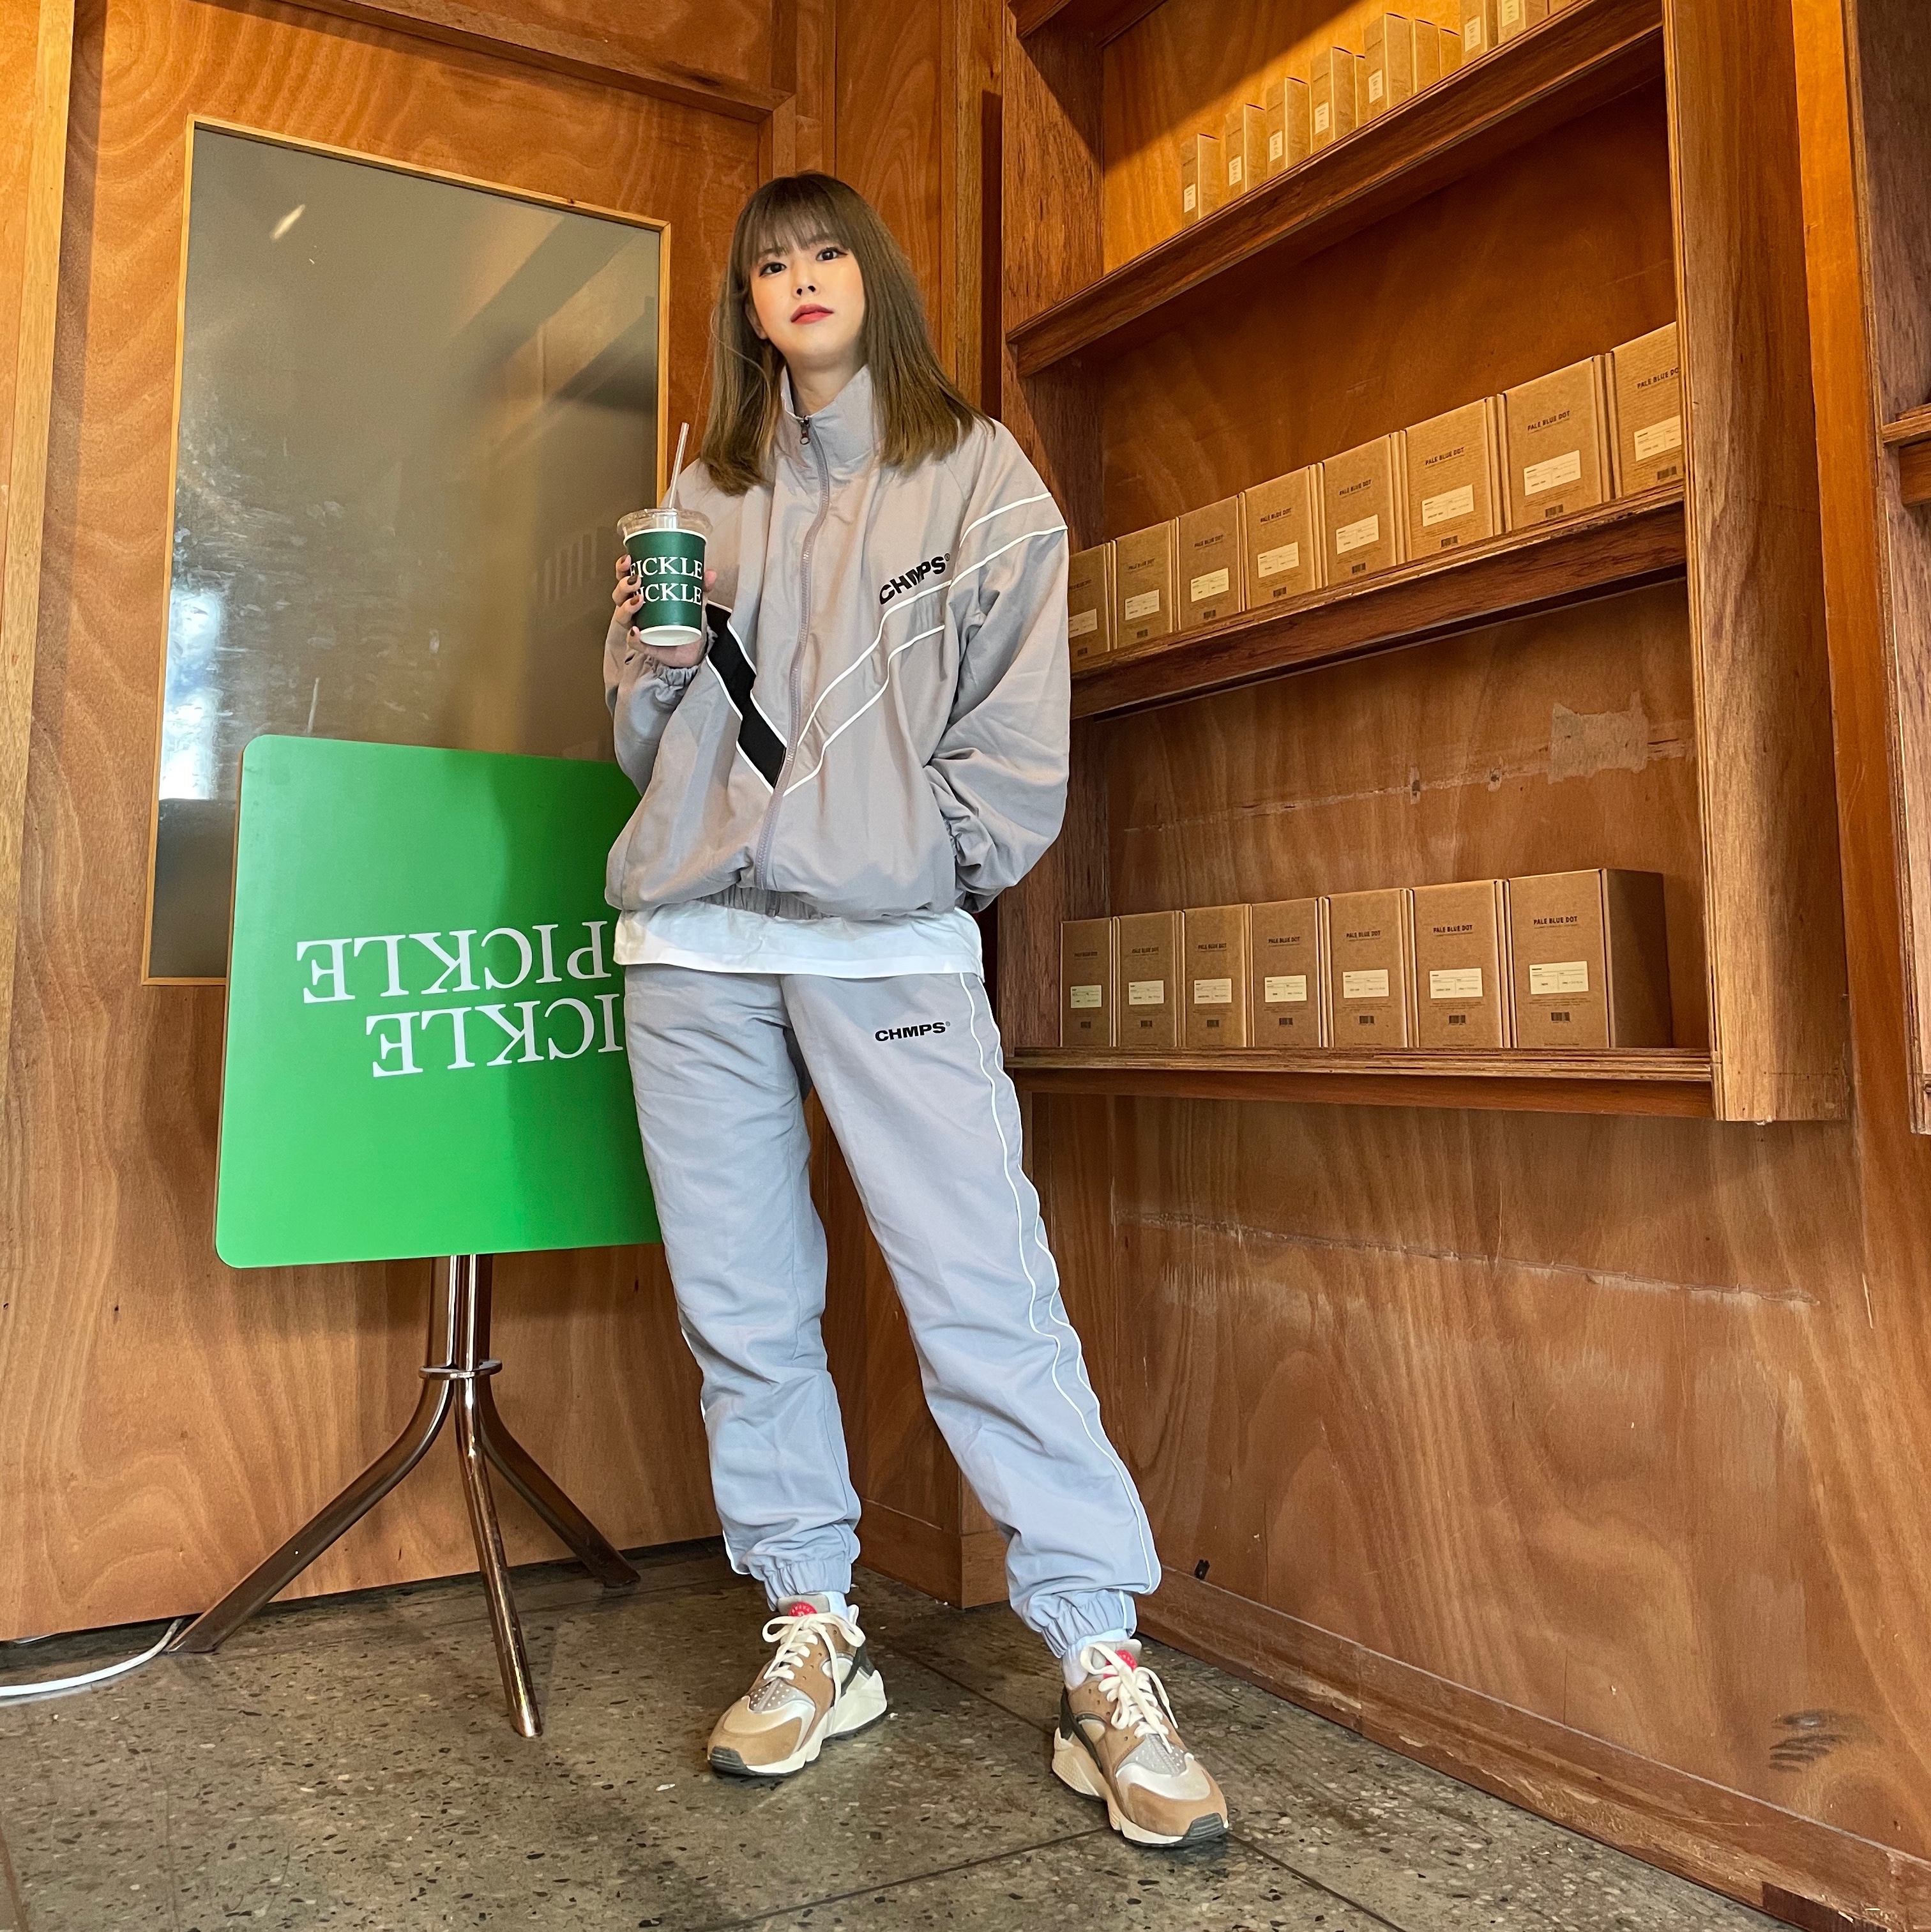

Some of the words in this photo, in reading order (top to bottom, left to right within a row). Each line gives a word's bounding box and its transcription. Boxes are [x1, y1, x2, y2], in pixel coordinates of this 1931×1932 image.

[1637, 378, 1651, 389] PALE
[1653, 372, 1668, 383] BLUE
[1670, 367, 1679, 376] DO
[1527, 422, 1541, 431] PALE
[1543, 415, 1557, 426] BLUE
[1558, 411, 1570, 420] DOT
[1425, 456, 1437, 465] PALE
[1439, 451, 1452, 460] BLUE
[633, 582, 702, 605] ICKLE
[296, 920, 612, 1004] PICKLE
[365, 993, 623, 1077] ICKLE
